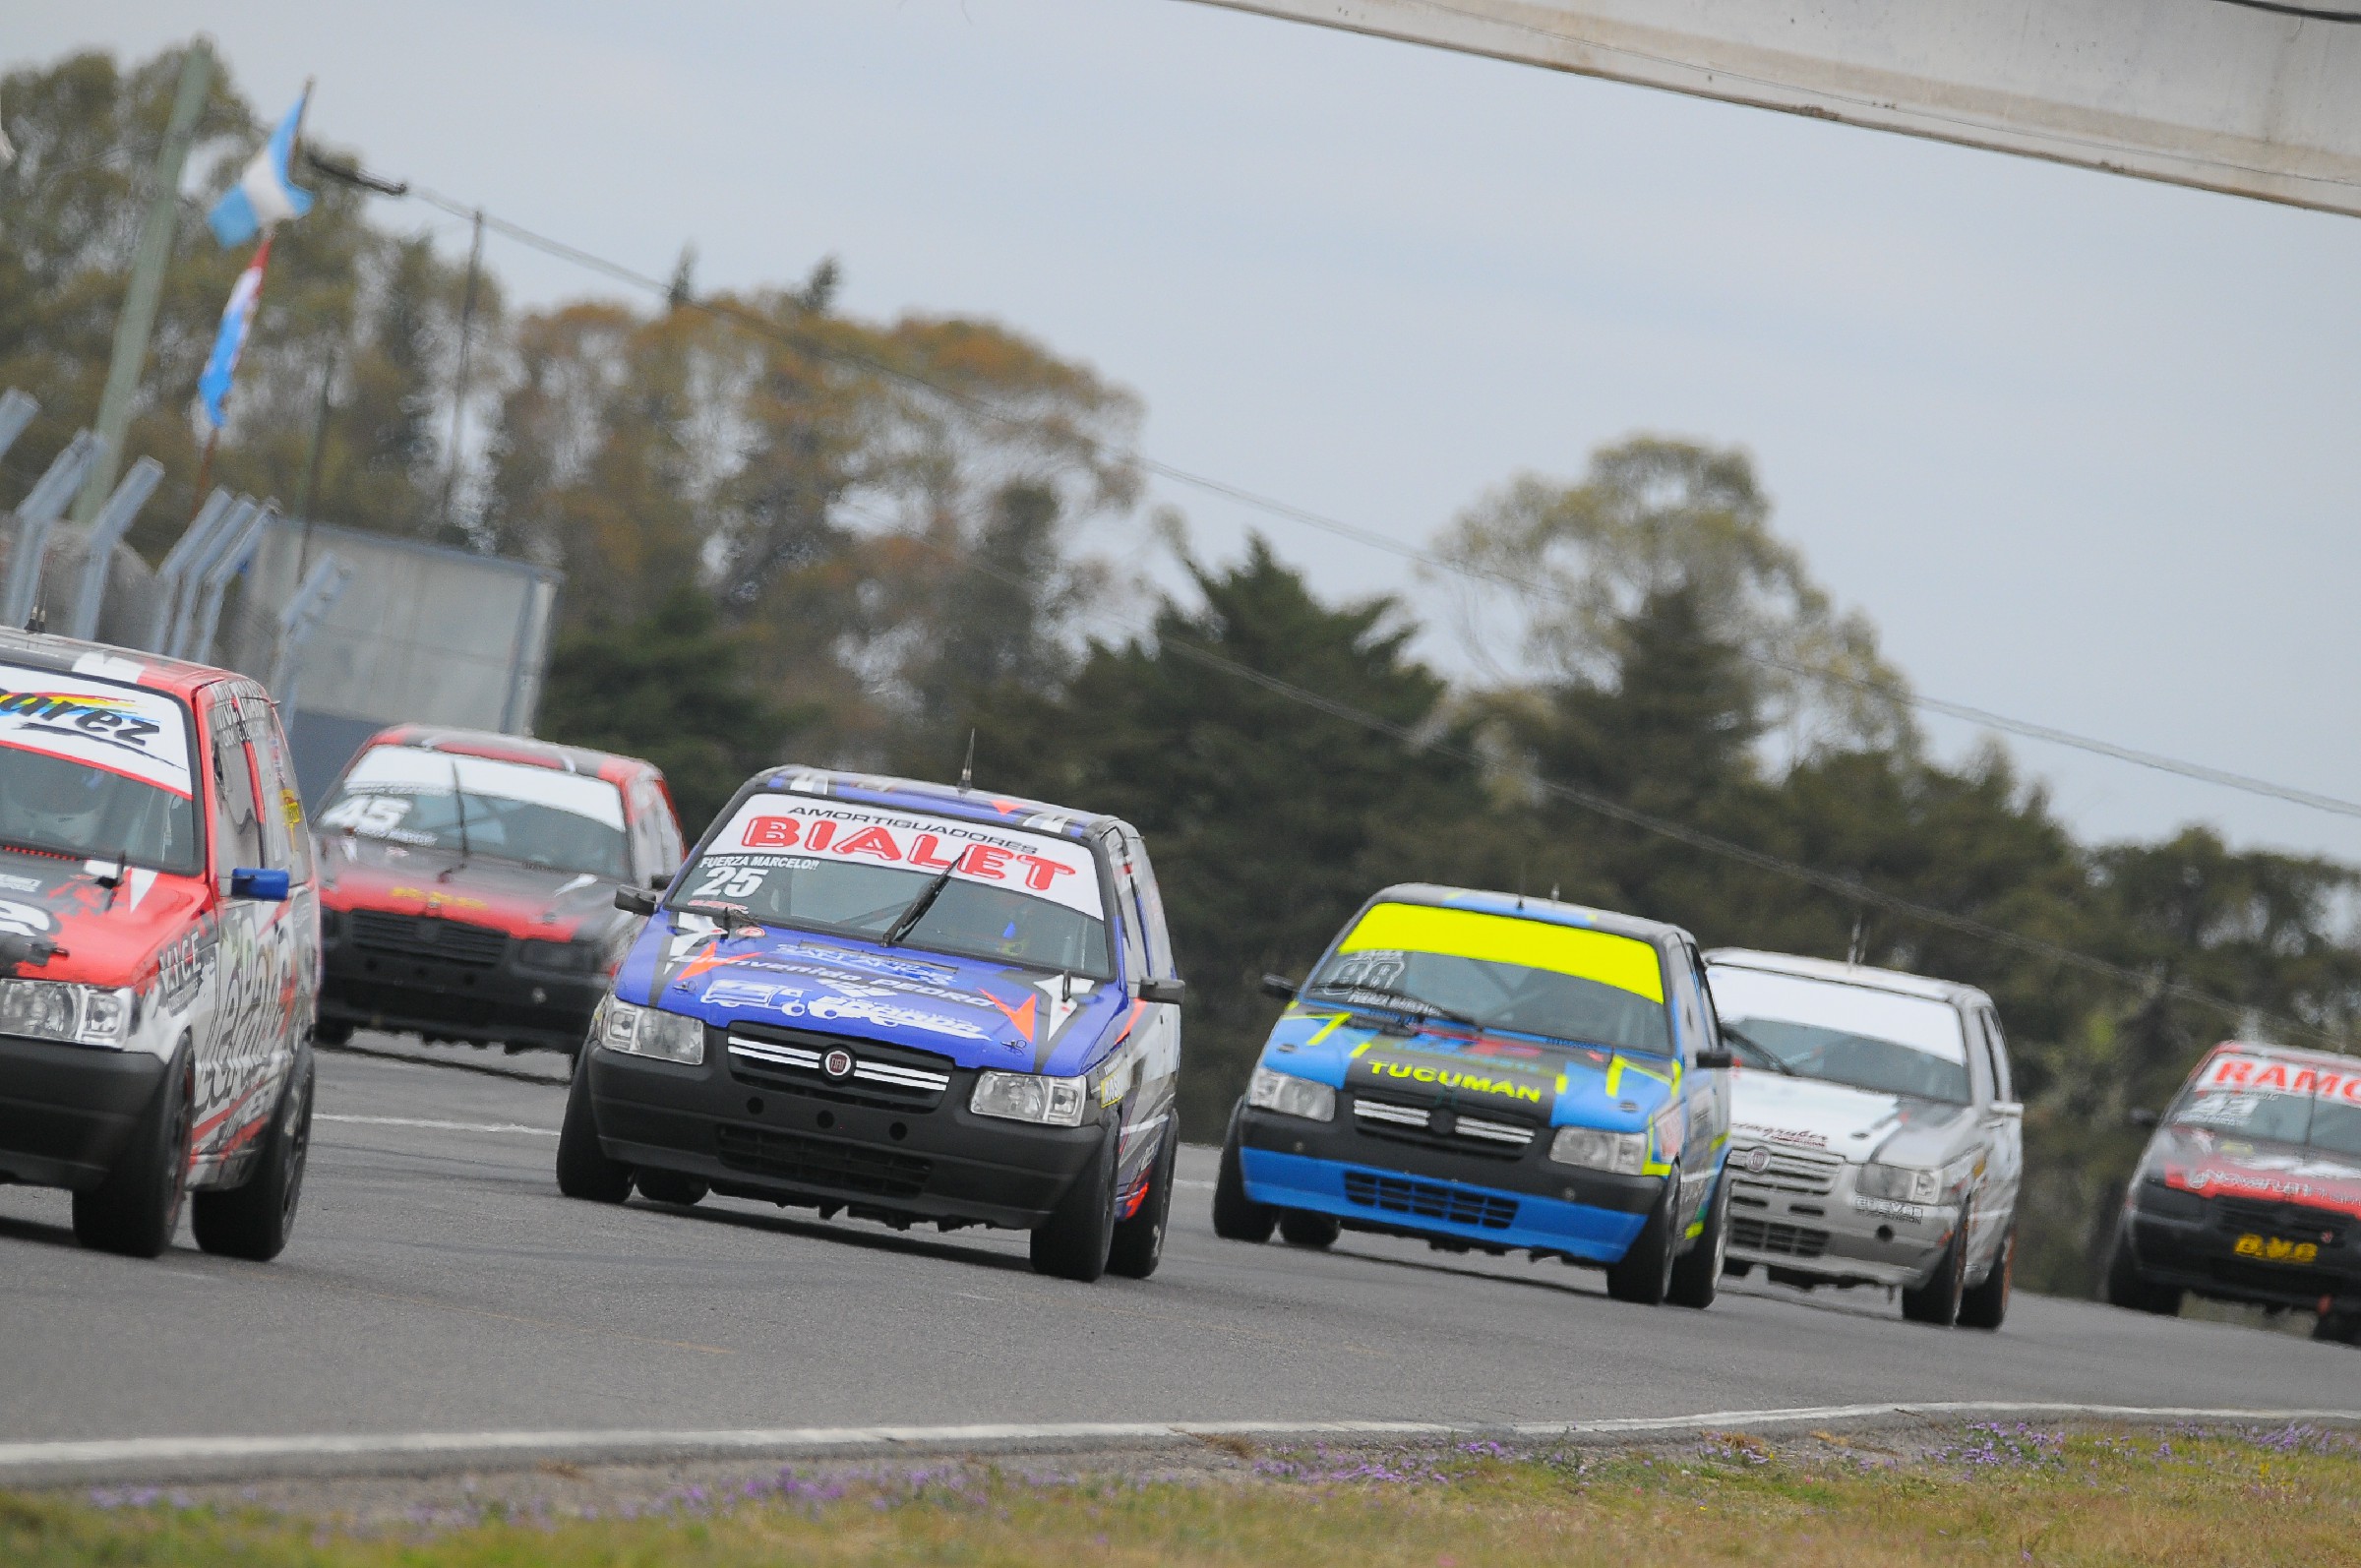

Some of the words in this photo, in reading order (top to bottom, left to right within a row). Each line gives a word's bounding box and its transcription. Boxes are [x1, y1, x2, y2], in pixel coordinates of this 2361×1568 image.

[0, 687, 160, 746] arez
[788, 807, 1038, 854] AMORTIGUADORES
[699, 856, 748, 868] FUERZA
[741, 815, 1076, 891] BIALET
[693, 867, 768, 897] 25
[870, 979, 995, 1006] PEDRO
[1368, 1059, 1542, 1103] TUCUMAN
